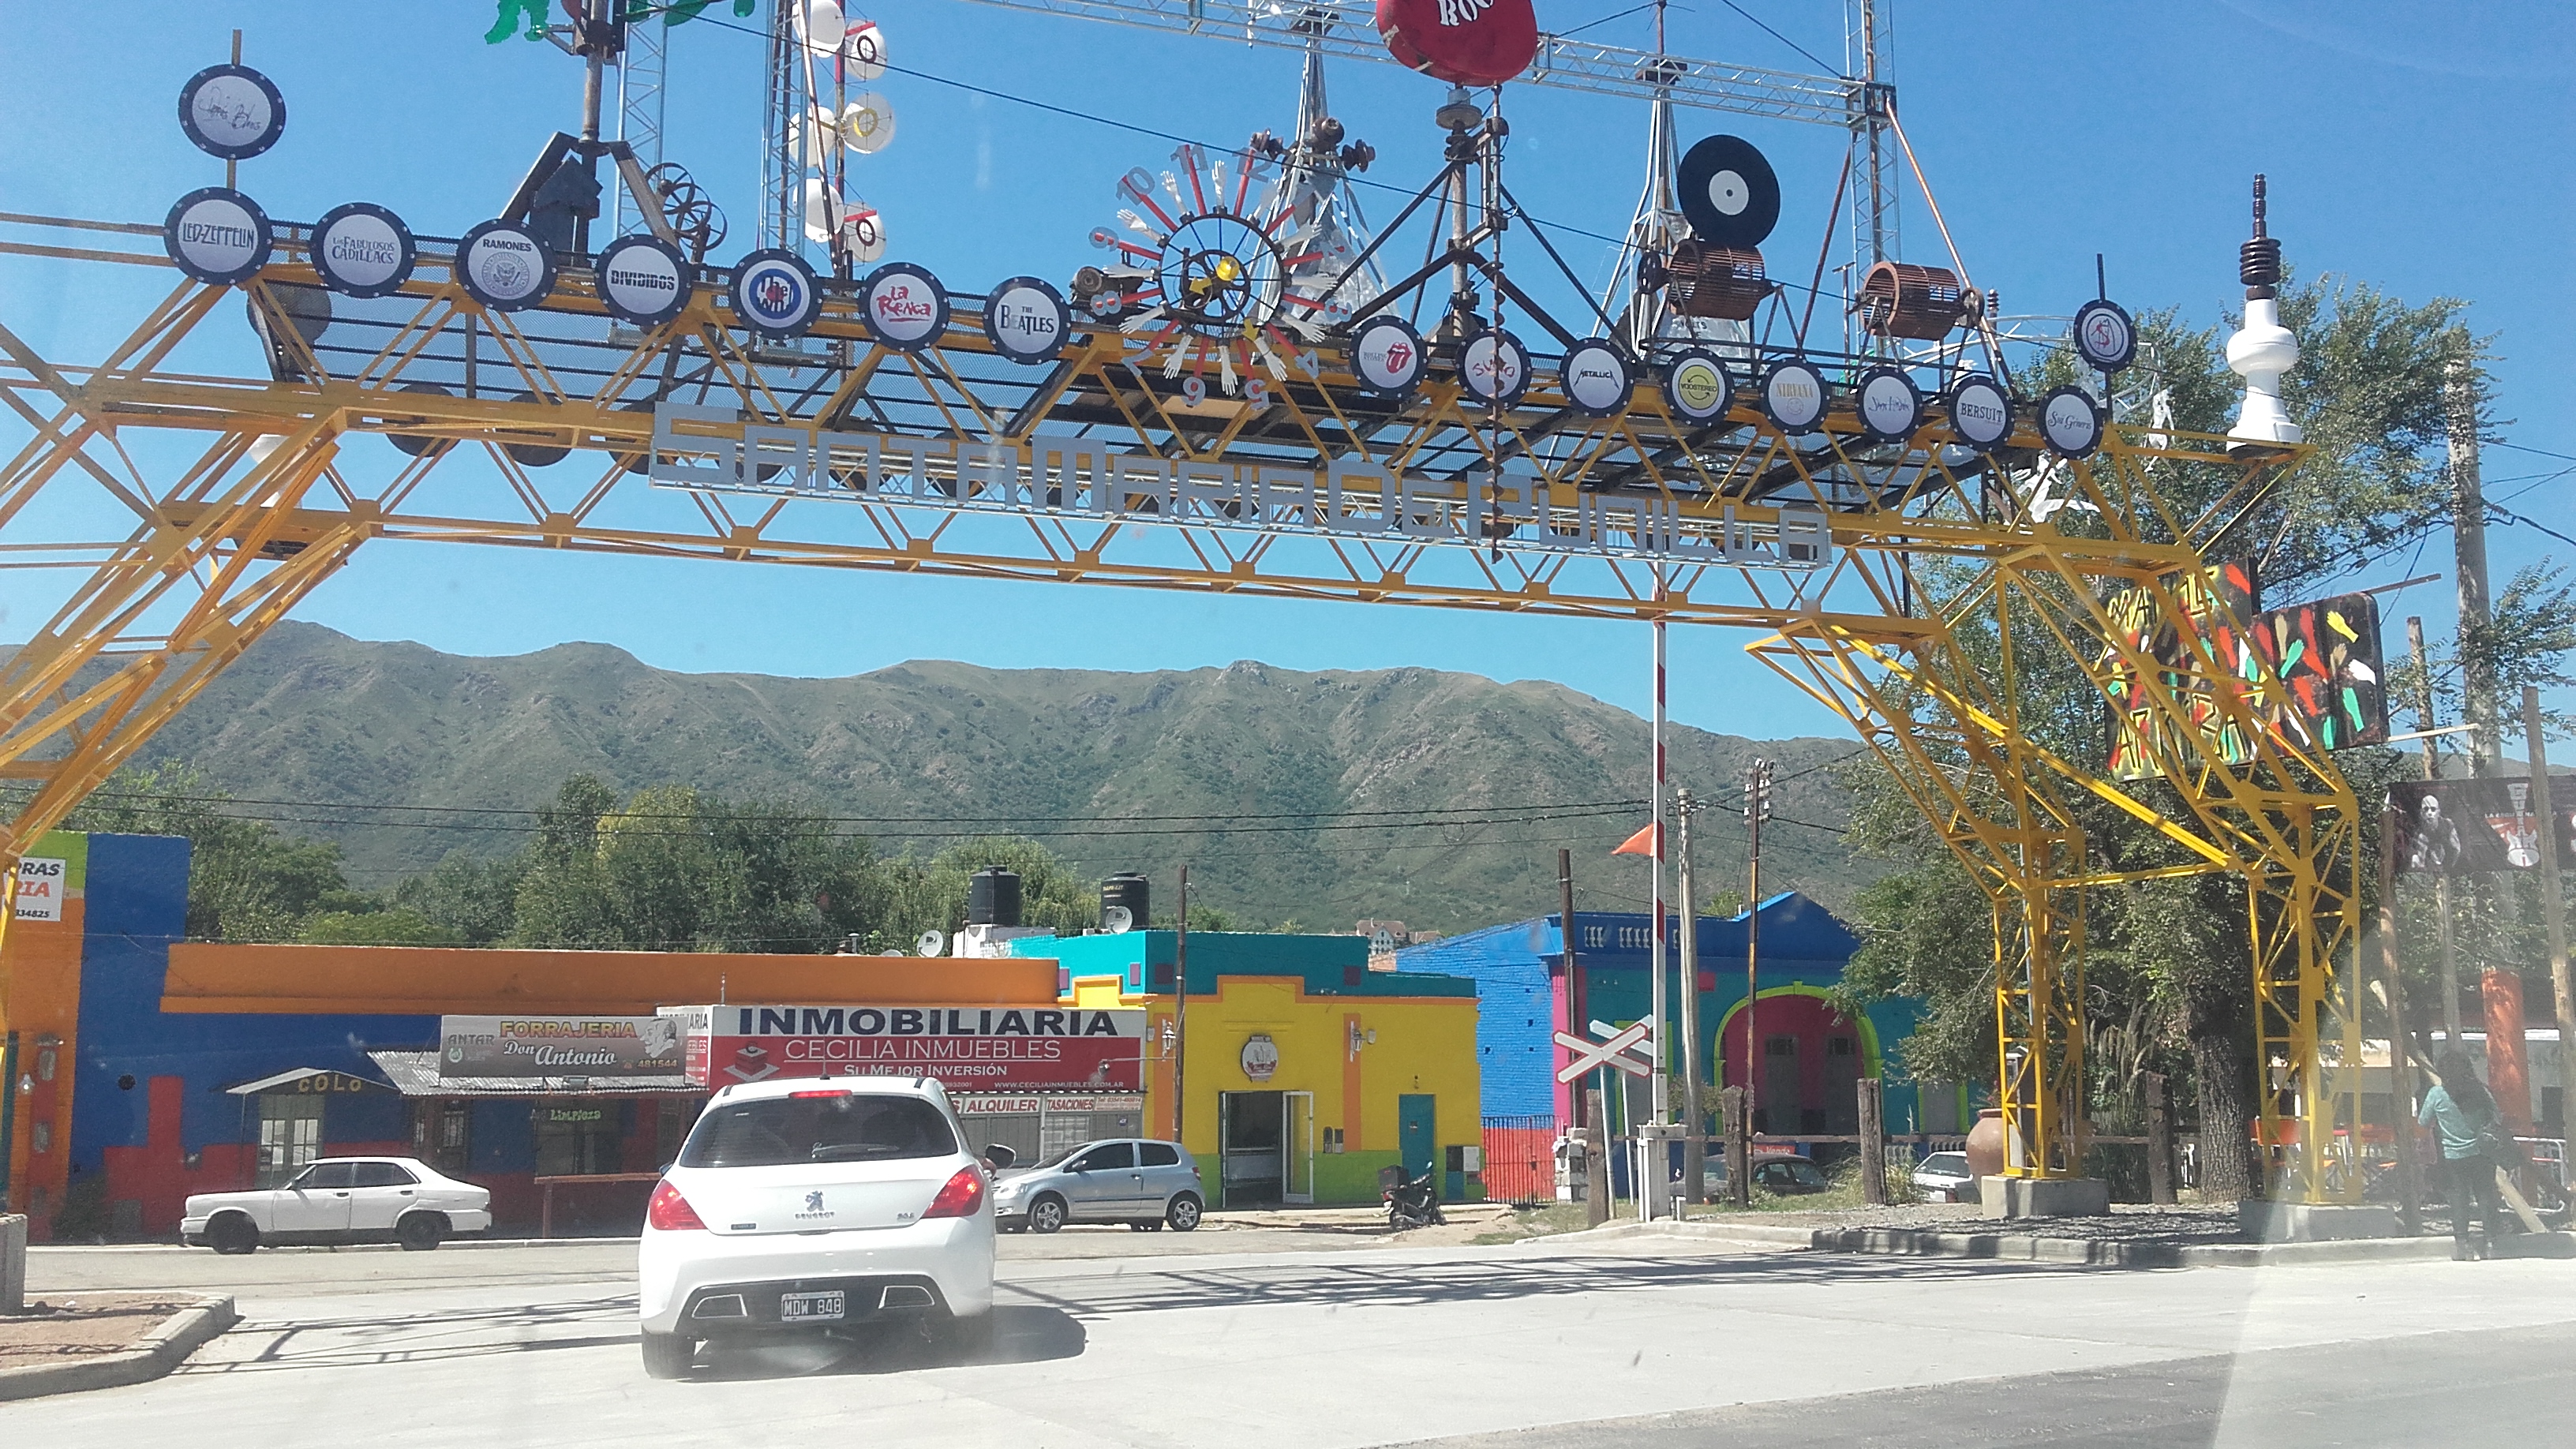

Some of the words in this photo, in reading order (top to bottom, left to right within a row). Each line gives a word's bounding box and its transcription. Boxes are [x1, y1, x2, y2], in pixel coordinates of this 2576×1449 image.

[343, 236, 395, 251] FABULOSOS
[483, 238, 532, 252] RAMONES
[331, 245, 395, 264] CADILLACS
[610, 269, 675, 290] DIVIDIDOS
[1000, 304, 1054, 335] BEATLES
[1472, 358, 1515, 378] SUO
[1574, 368, 1620, 390] METALLICA
[1777, 383, 1813, 398] NIRVANA
[1960, 402, 2003, 422] BERSUIT
[653, 402, 1017, 507] SANTA
[1032, 435, 1316, 530] MARIA
[1466, 471, 1828, 567] PUNILLA
[19, 862, 61, 876] RAS
[500, 1020, 638, 1039] FORRAJERIA
[688, 1013, 709, 1030] ARIA
[739, 1008, 1118, 1036] INMOBILIARIA
[447, 1034, 496, 1046] ANTAR
[503, 1040, 537, 1056] Don
[534, 1044, 618, 1065] Antonio
[785, 1039, 897, 1060] CECILIA
[906, 1039, 1061, 1060] INMUEBLES
[637, 1058, 678, 1069] 481544
[871, 1064, 923, 1076] MEJOR
[927, 1062, 1007, 1076] INVERSIÓN
[298, 1074, 362, 1092] COLO
[966, 1099, 1038, 1112] ALQUILER
[1047, 1099, 1094, 1111] TASACIONES
[784, 1299, 809, 1316] MDW
